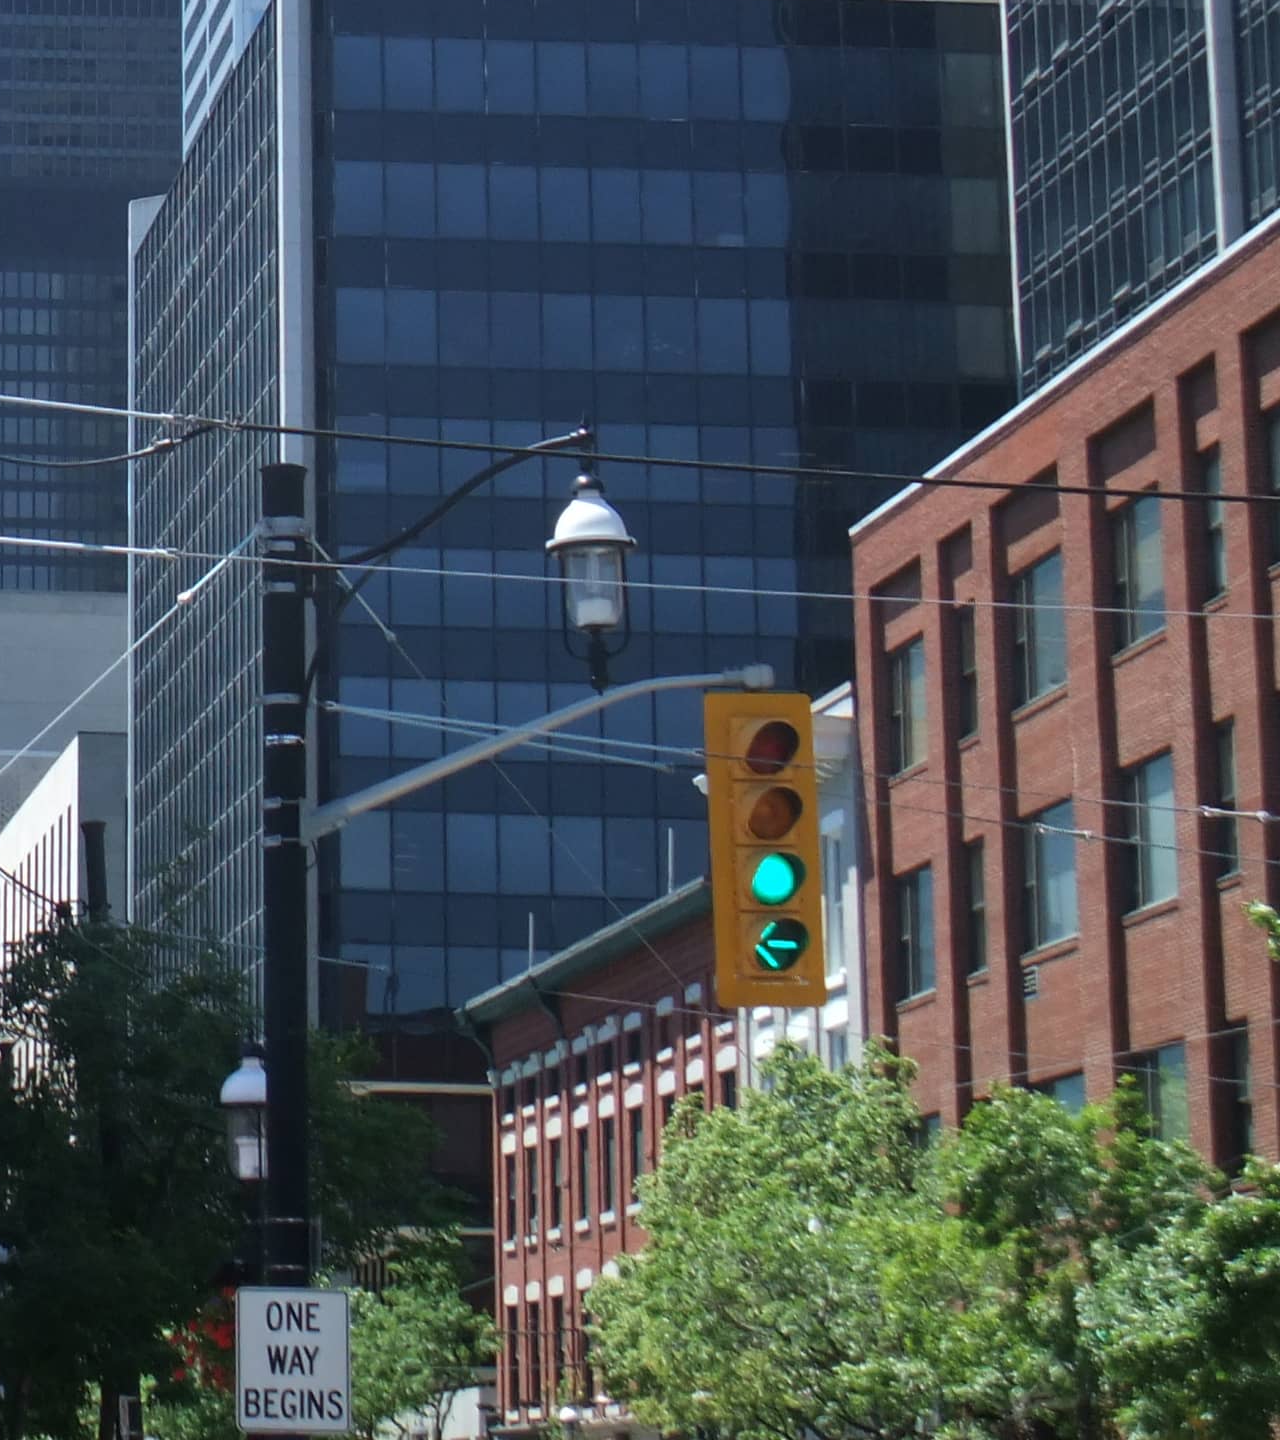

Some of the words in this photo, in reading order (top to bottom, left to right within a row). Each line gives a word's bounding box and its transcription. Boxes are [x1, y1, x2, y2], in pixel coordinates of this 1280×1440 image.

[266, 1301, 321, 1332] ONE
[267, 1345, 320, 1376] WAY
[244, 1387, 344, 1421] BEGINS
